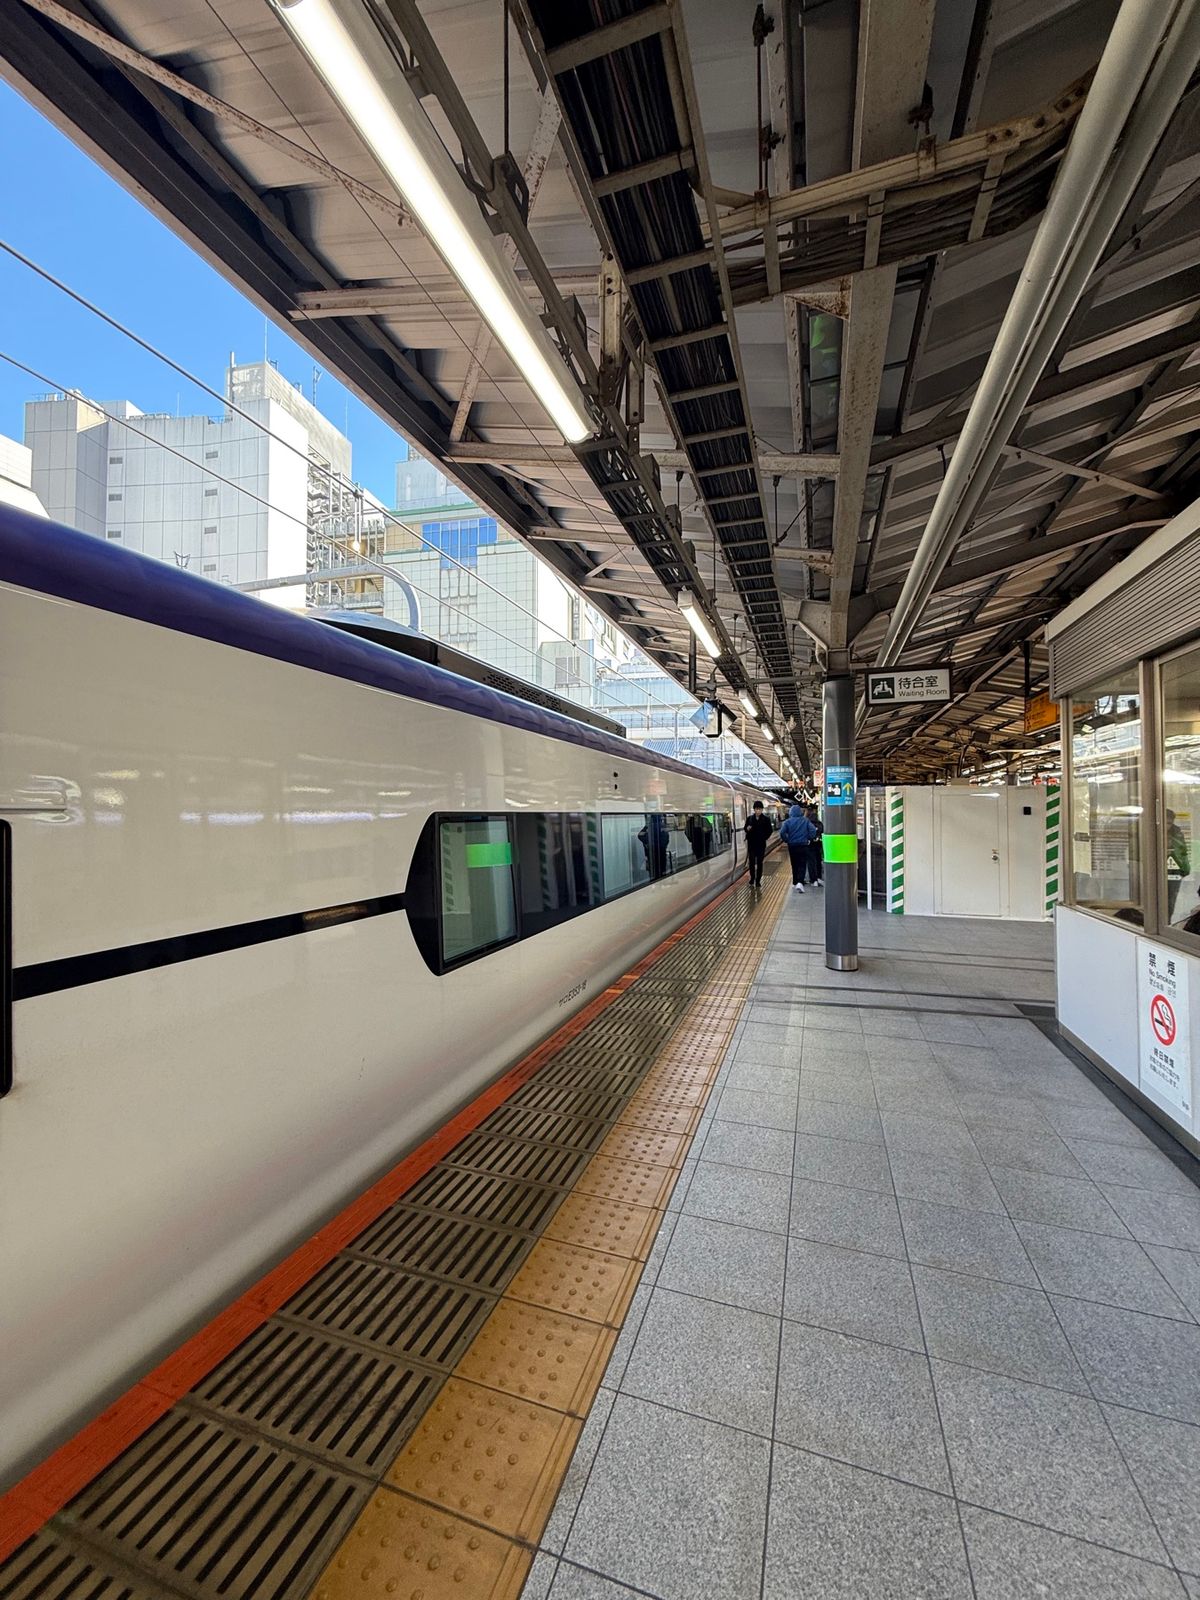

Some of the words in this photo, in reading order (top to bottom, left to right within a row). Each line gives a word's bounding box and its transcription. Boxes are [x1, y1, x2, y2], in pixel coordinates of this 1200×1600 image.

[898, 675, 939, 690] 待合室
[1148, 968, 1156, 978] No
[1156, 970, 1177, 990] Smoking
